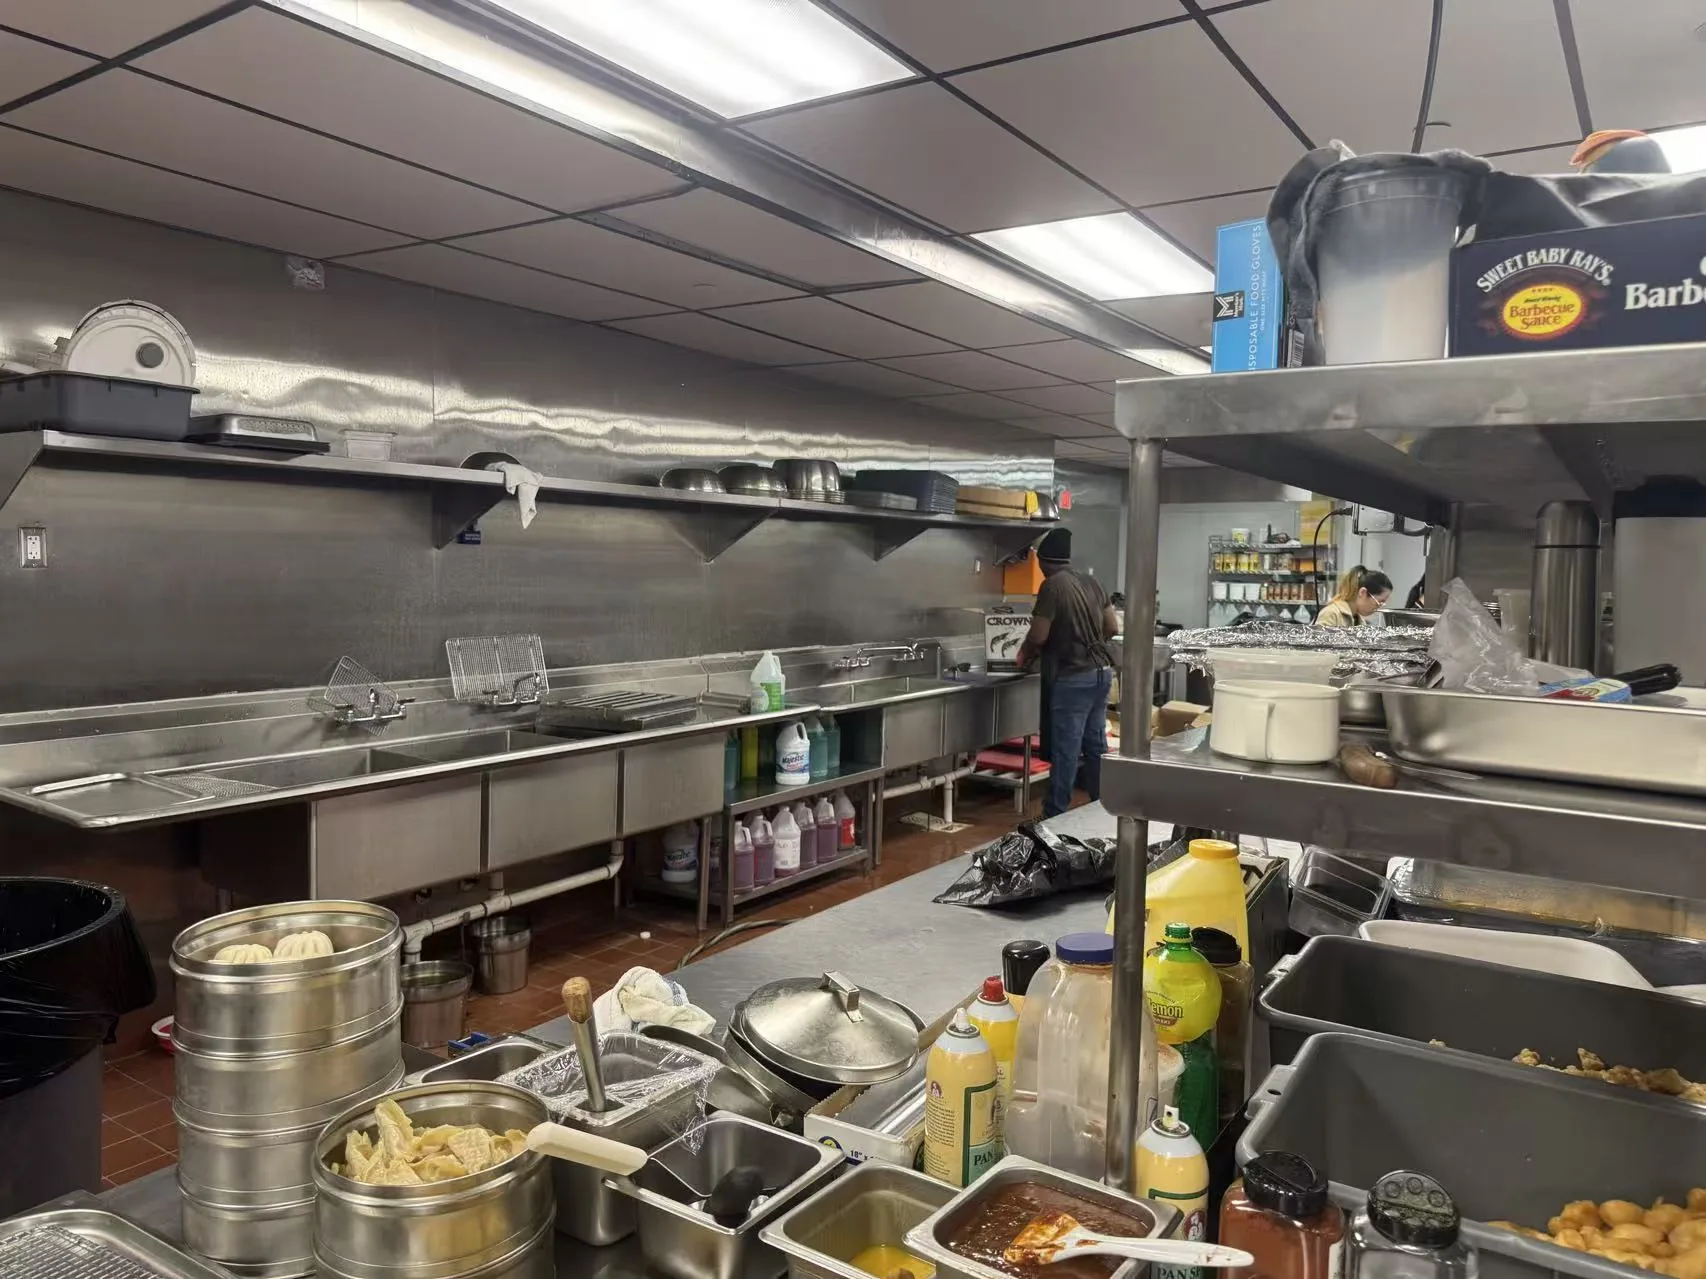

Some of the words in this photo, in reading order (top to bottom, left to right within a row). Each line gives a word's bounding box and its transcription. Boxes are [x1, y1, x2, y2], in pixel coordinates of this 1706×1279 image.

[1251, 224, 1262, 270] GLOVES
[1476, 254, 1525, 293] SWEET
[1526, 248, 1570, 266] BABY
[1569, 250, 1615, 282] RAY'S
[1250, 274, 1260, 306] FOOD
[1624, 277, 1706, 310] Barb
[1510, 302, 1575, 318] Barbecue
[1521, 315, 1561, 330] Sauce
[1248, 311, 1259, 371] ISPOSABLE
[986, 616, 1033, 626] CROWN
[1149, 998, 1184, 1018] emon
